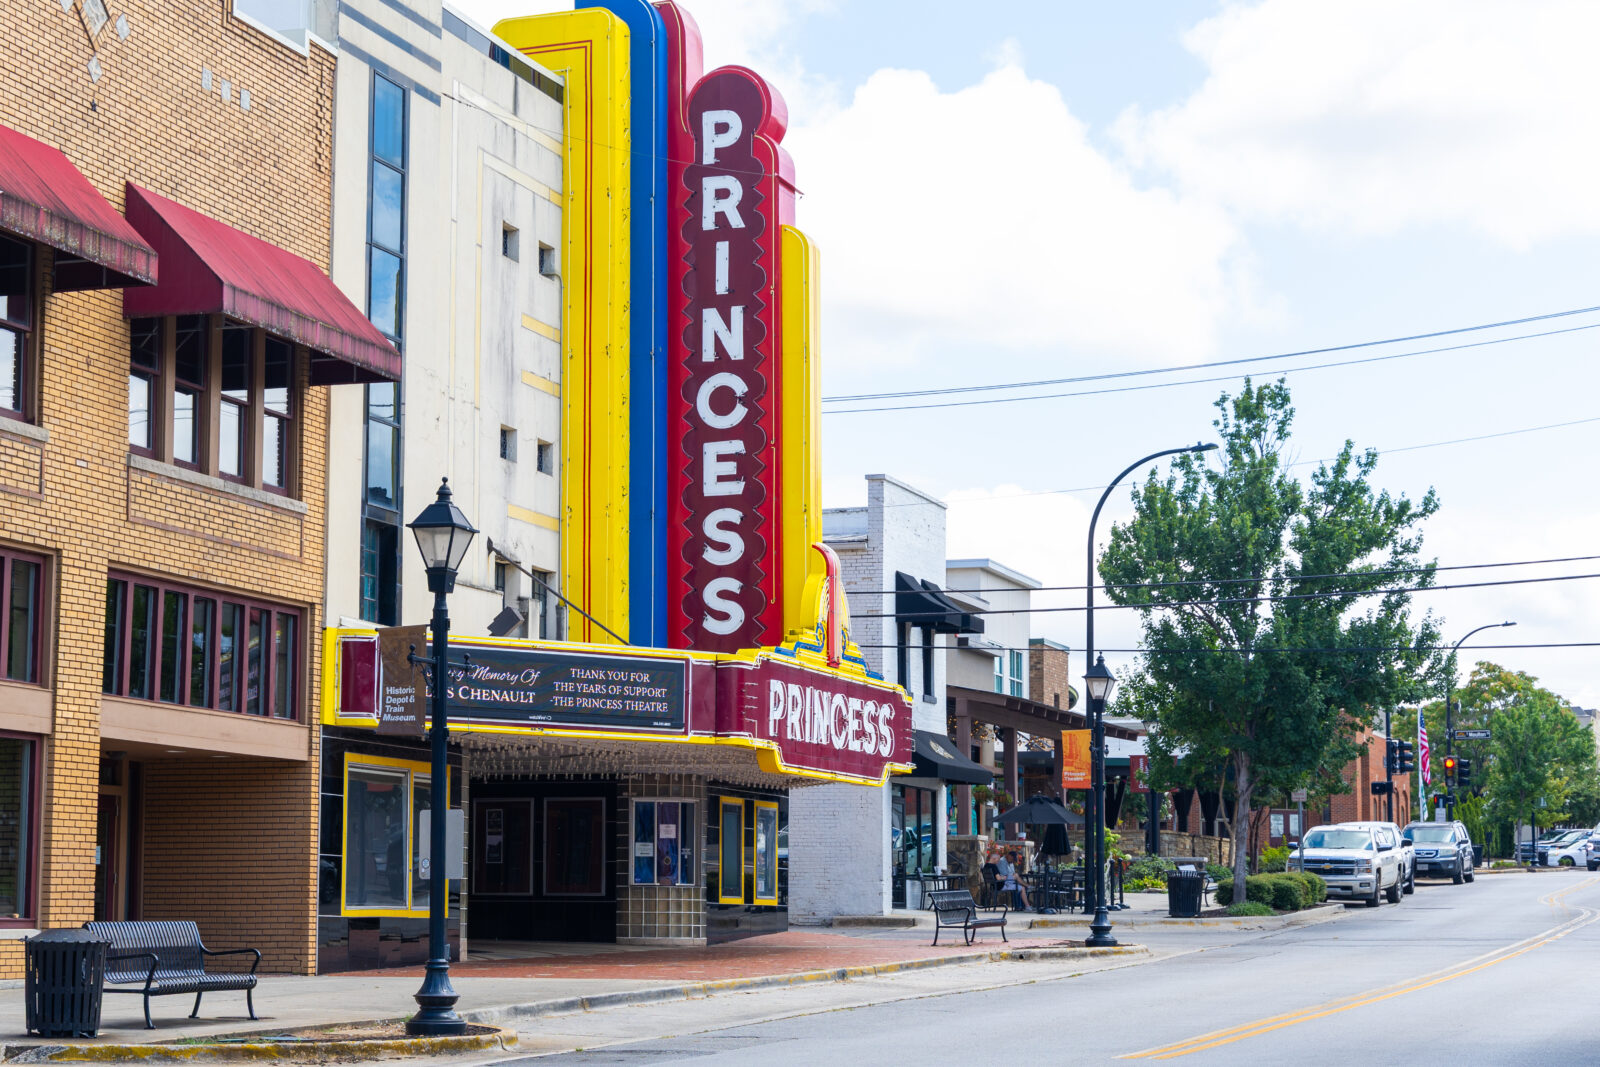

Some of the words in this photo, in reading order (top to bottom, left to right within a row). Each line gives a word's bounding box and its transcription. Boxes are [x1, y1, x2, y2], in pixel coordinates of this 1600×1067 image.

[696, 109, 749, 635] PRINCESS
[468, 664, 519, 685] Memory
[520, 668, 541, 687] Of
[570, 668, 605, 680] THANK
[607, 670, 628, 681] YOU
[630, 672, 650, 683] FOR
[385, 685, 416, 695] Historic
[458, 685, 536, 703] CHENAULT
[553, 681, 575, 692] THE
[576, 683, 607, 694] YEARS
[608, 685, 622, 695] OF
[623, 686, 667, 698] SUPPORT
[385, 695, 409, 705] Depot
[409, 694, 415, 703] &
[550, 695, 575, 707] -THE
[576, 697, 623, 710] PRINCESS
[624, 700, 669, 713] THEATRE
[385, 704, 405, 713] Train
[383, 713, 416, 722] Museum
[768, 678, 896, 758] PRINCESS
